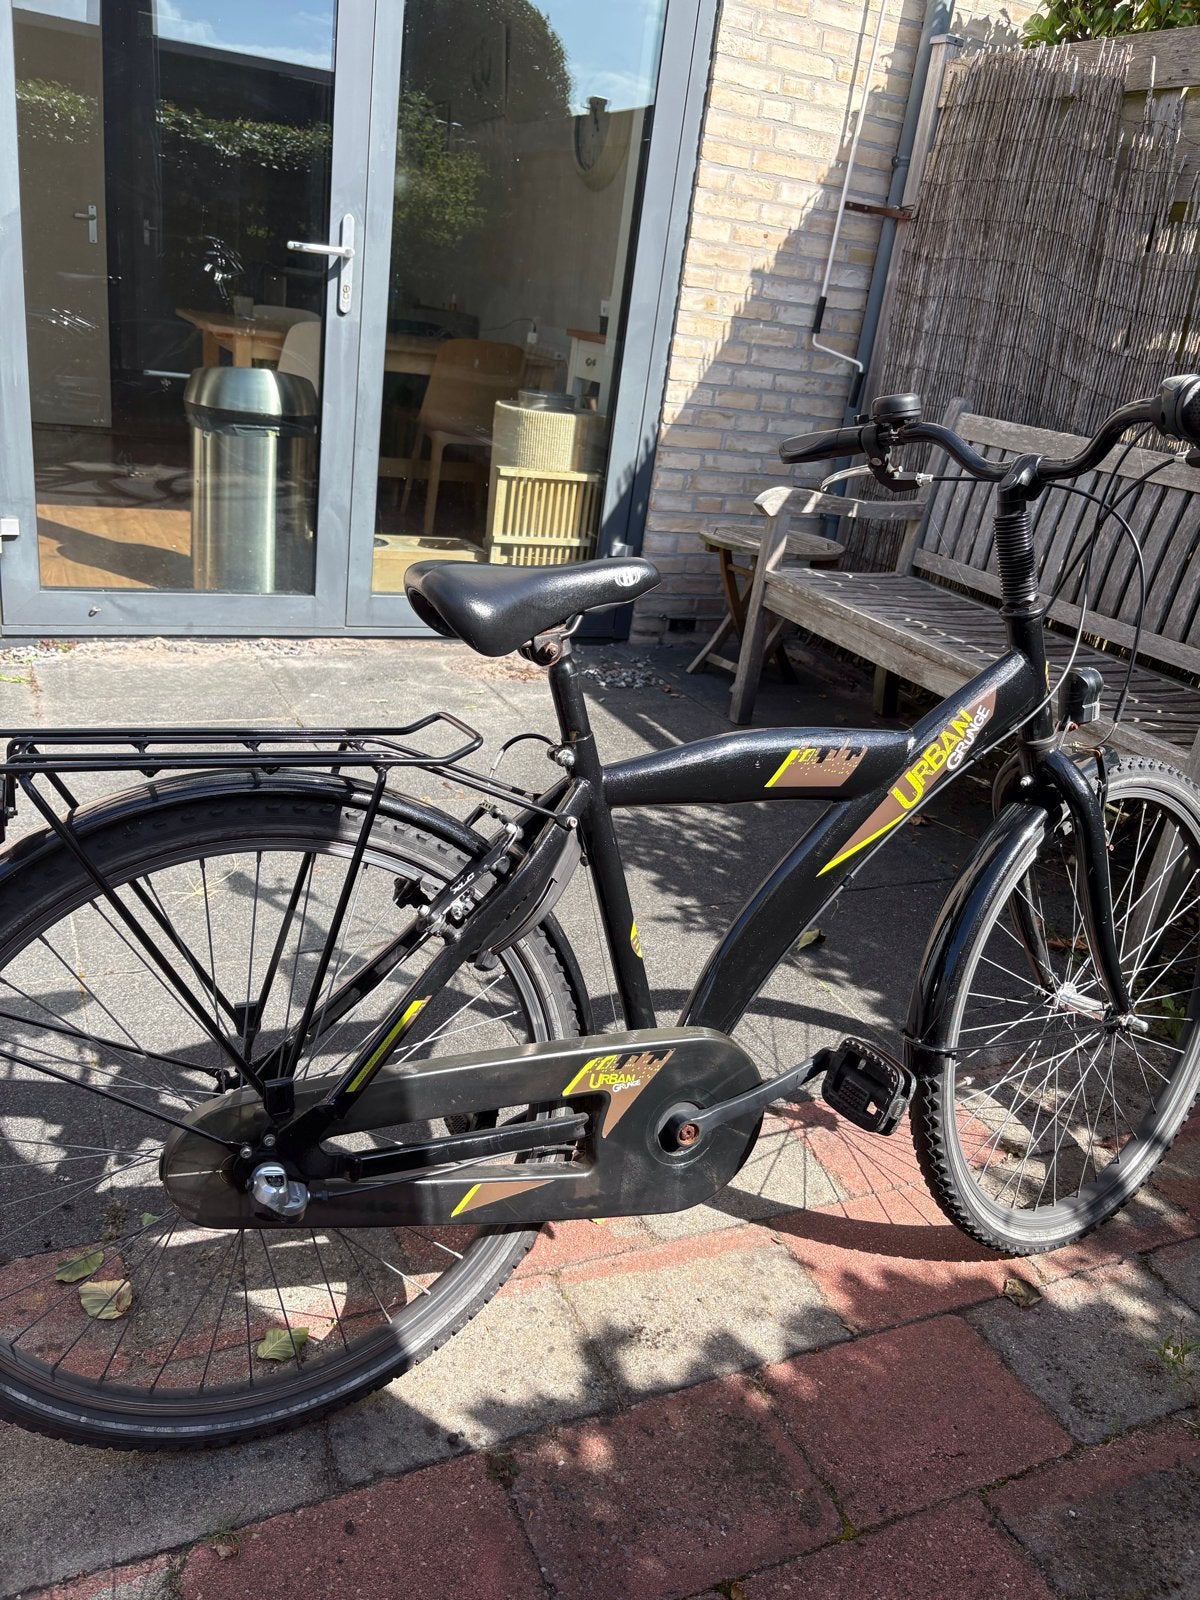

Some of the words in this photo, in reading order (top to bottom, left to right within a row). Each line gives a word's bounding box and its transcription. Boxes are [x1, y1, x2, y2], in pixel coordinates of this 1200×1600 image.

[946, 704, 991, 770] GRUNGE
[890, 708, 973, 810] URBAN
[589, 1073, 636, 1089] URBAN
[612, 1079, 641, 1092] GRUNGE
